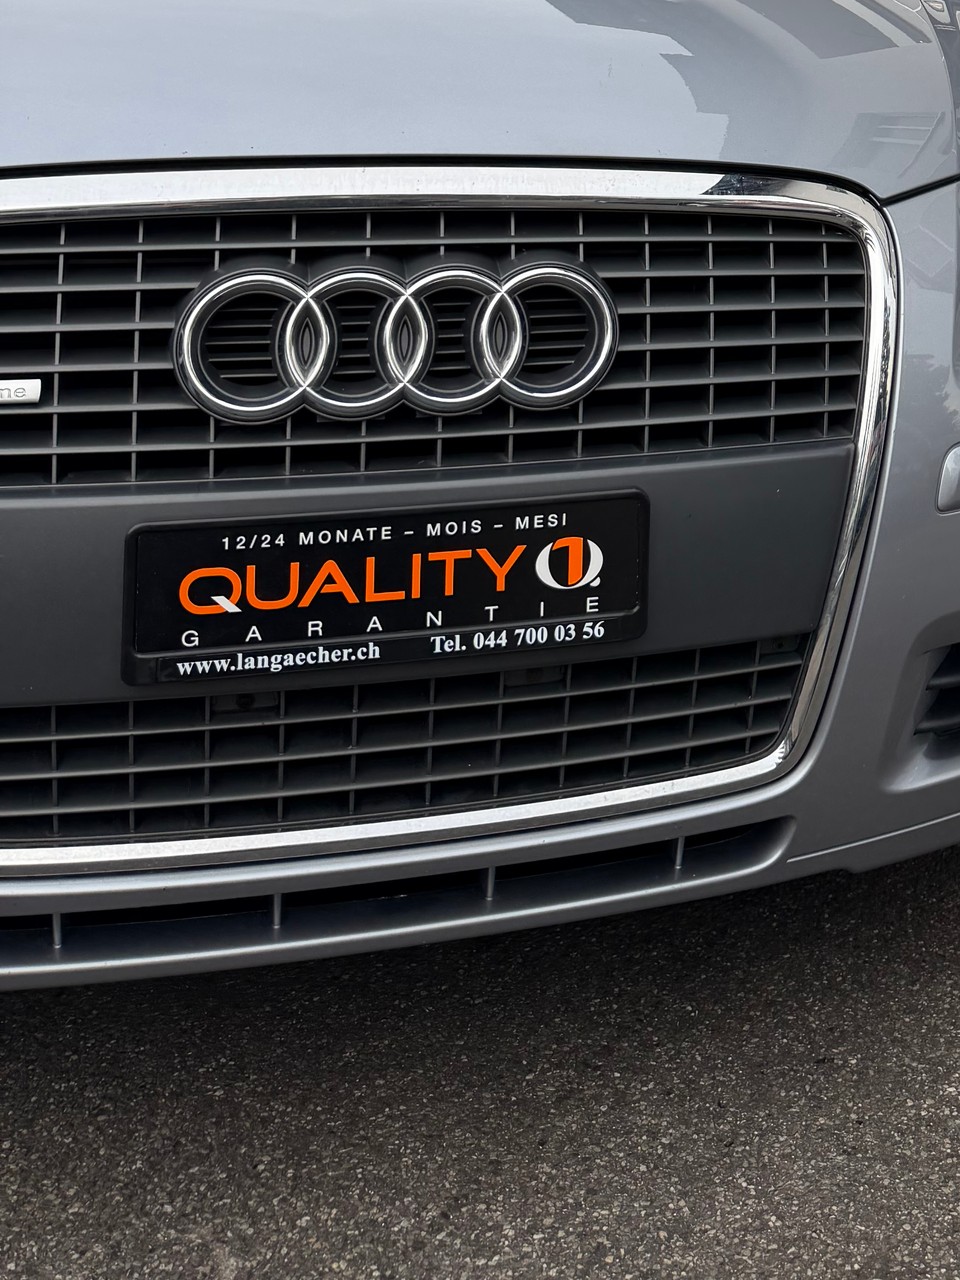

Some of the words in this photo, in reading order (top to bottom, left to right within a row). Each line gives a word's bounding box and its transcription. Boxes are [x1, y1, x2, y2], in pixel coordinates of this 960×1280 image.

[221, 533, 286, 551] 12/24
[298, 526, 392, 546] MONATE
[426, 519, 482, 538] MOIS
[515, 512, 567, 531] MESI
[178, 544, 528, 615] QUALITY
[430, 634, 467, 654] Tel.
[472, 629, 508, 650] 044
[513, 626, 548, 647] 700
[553, 622, 577, 642] 03
[582, 620, 606, 640] 56
[176, 641, 381, 677] www.langaecher.ch
